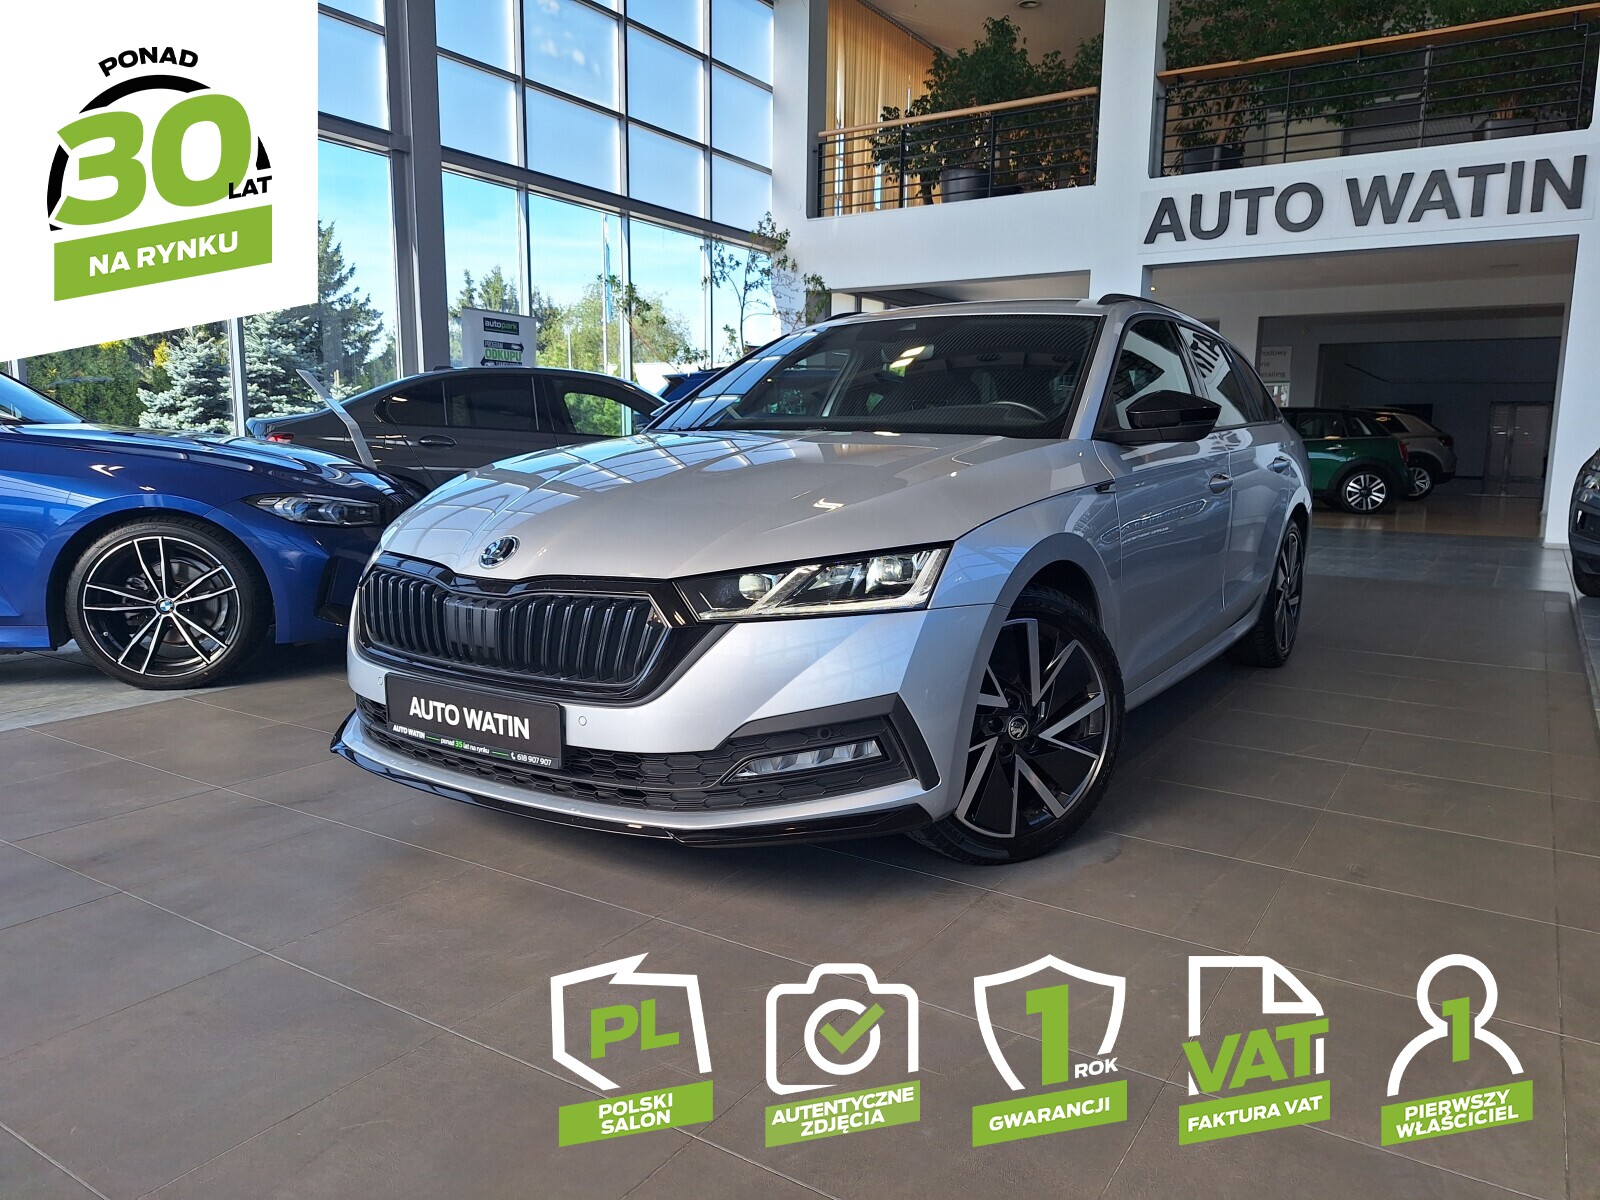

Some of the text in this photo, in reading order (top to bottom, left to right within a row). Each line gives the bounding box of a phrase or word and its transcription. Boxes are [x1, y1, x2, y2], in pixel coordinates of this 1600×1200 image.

[1144, 154, 1588, 245] AUTO WATIN
[484, 320, 518, 330] autopark
[485, 348, 522, 361] ODKUPU
[409, 697, 530, 740] AUTO WATIN
[393, 724, 426, 740] AUTO WATIN
[440, 738, 455, 746] ponad
[455, 740, 463, 748] 35
[477, 746, 490, 754] rynku
[516, 753, 552, 766] 618 907 907
